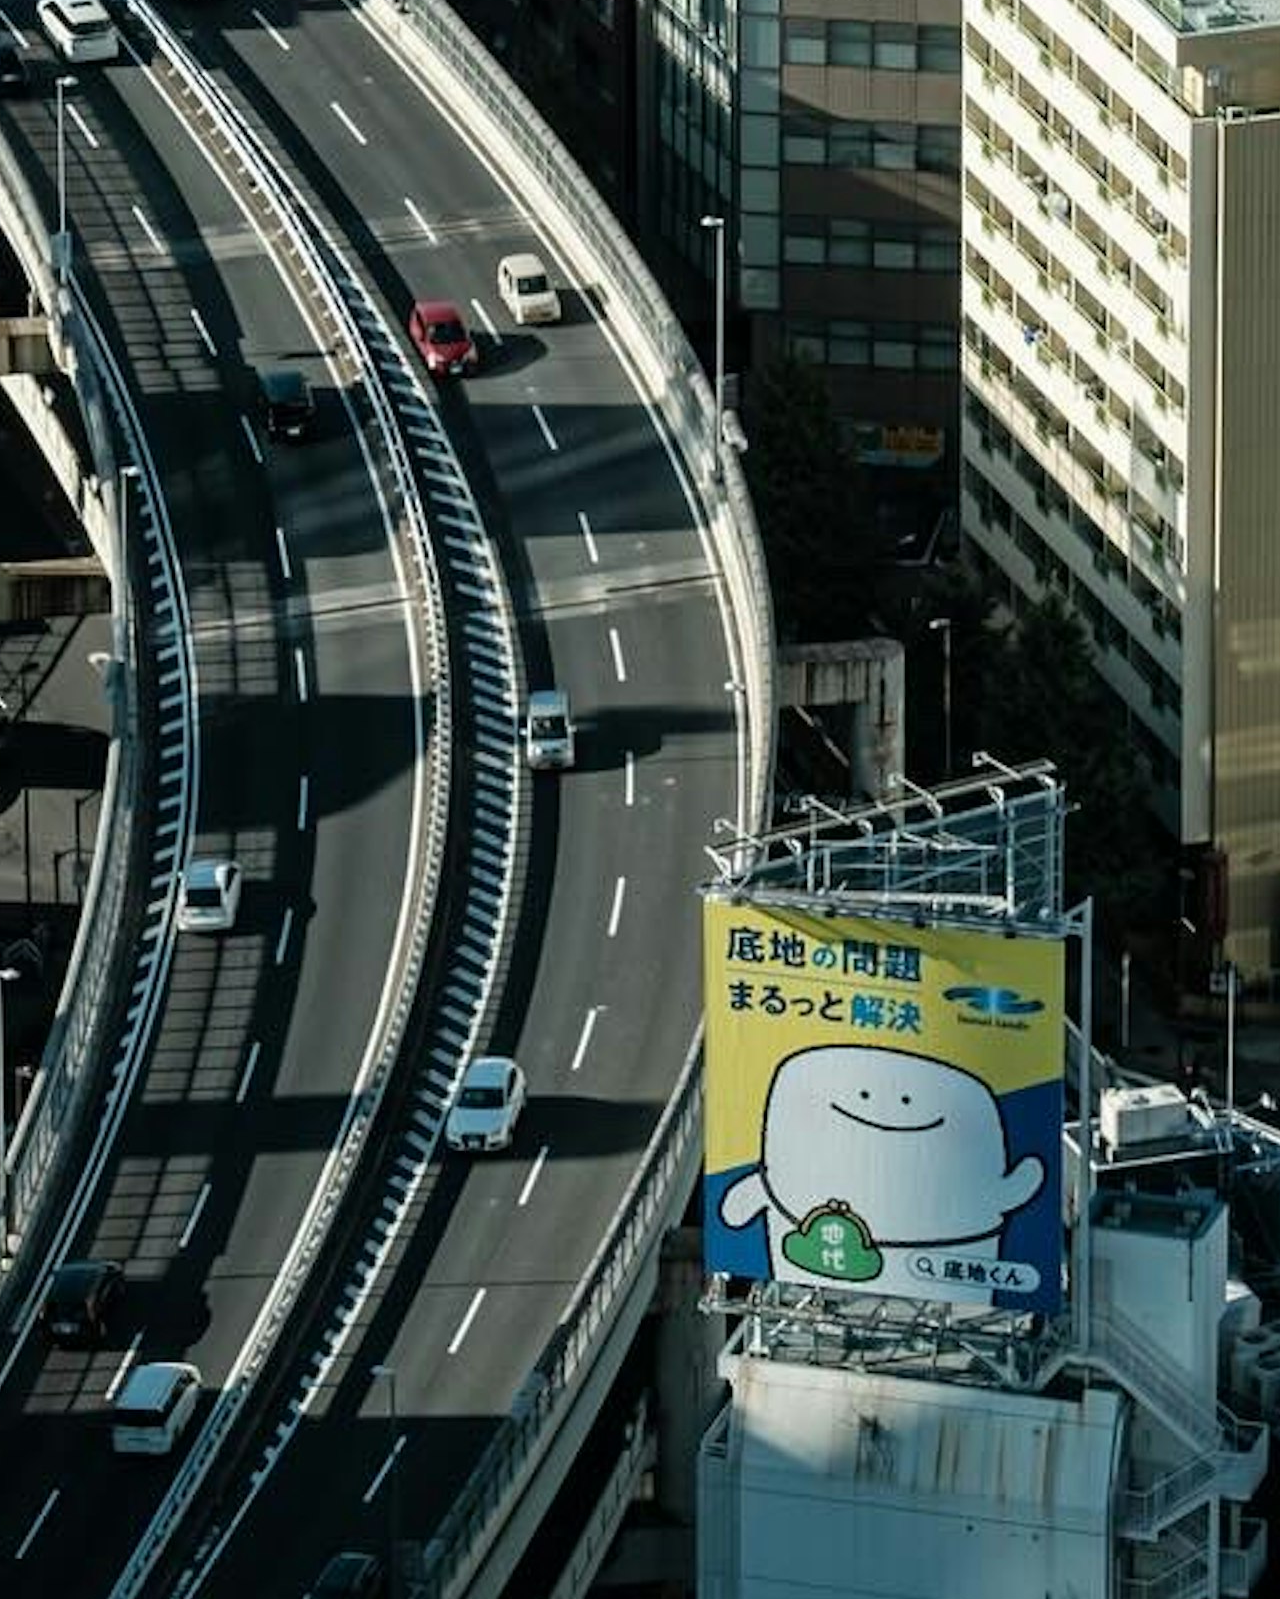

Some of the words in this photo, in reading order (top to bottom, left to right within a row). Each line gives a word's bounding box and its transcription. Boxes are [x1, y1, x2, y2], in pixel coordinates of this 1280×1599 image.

[726, 925, 922, 983] 底地の問題
[728, 981, 922, 1035] まるっと解決
